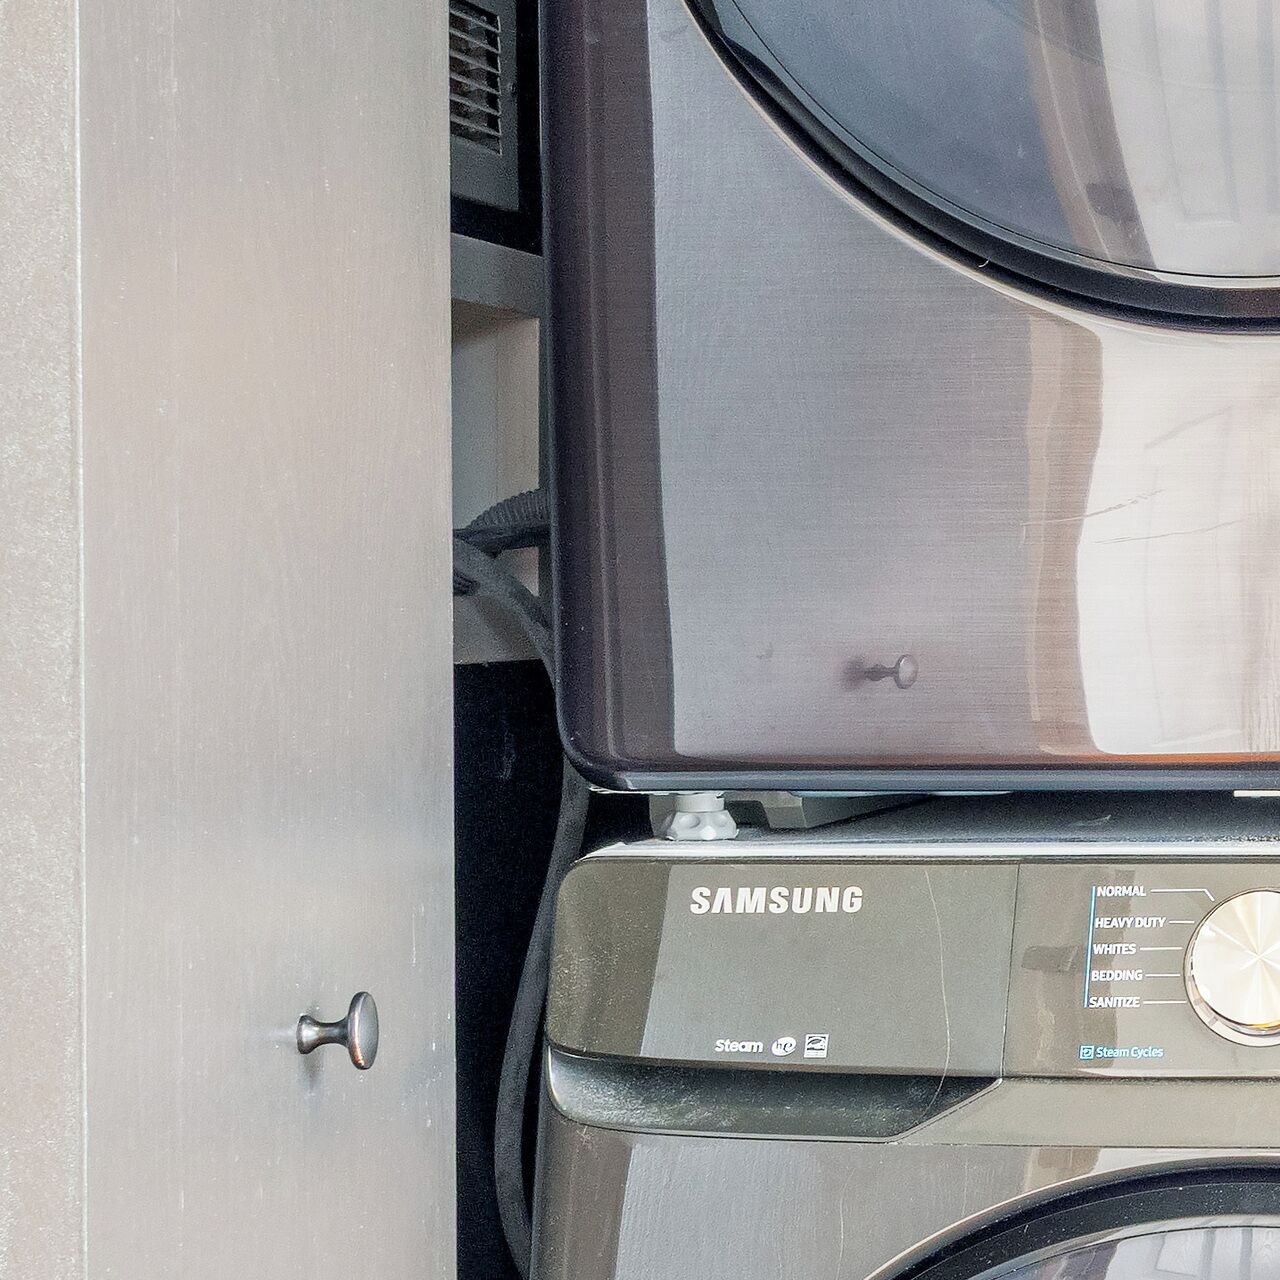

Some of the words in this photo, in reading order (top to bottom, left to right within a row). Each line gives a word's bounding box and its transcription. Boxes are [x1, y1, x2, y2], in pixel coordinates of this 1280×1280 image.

[1097, 886, 1146, 896] NORMAL
[690, 886, 863, 914] SAMSUNG
[1095, 918, 1132, 929] HEAVY
[1135, 917, 1166, 928] DUTY
[1093, 944, 1136, 955] WHITES
[1091, 970, 1143, 981] BEDDING
[1089, 997, 1140, 1008] SANITIZE
[714, 1039, 764, 1053] Steam
[1096, 1046, 1129, 1058] Steam
[1131, 1046, 1163, 1059] Cycles
